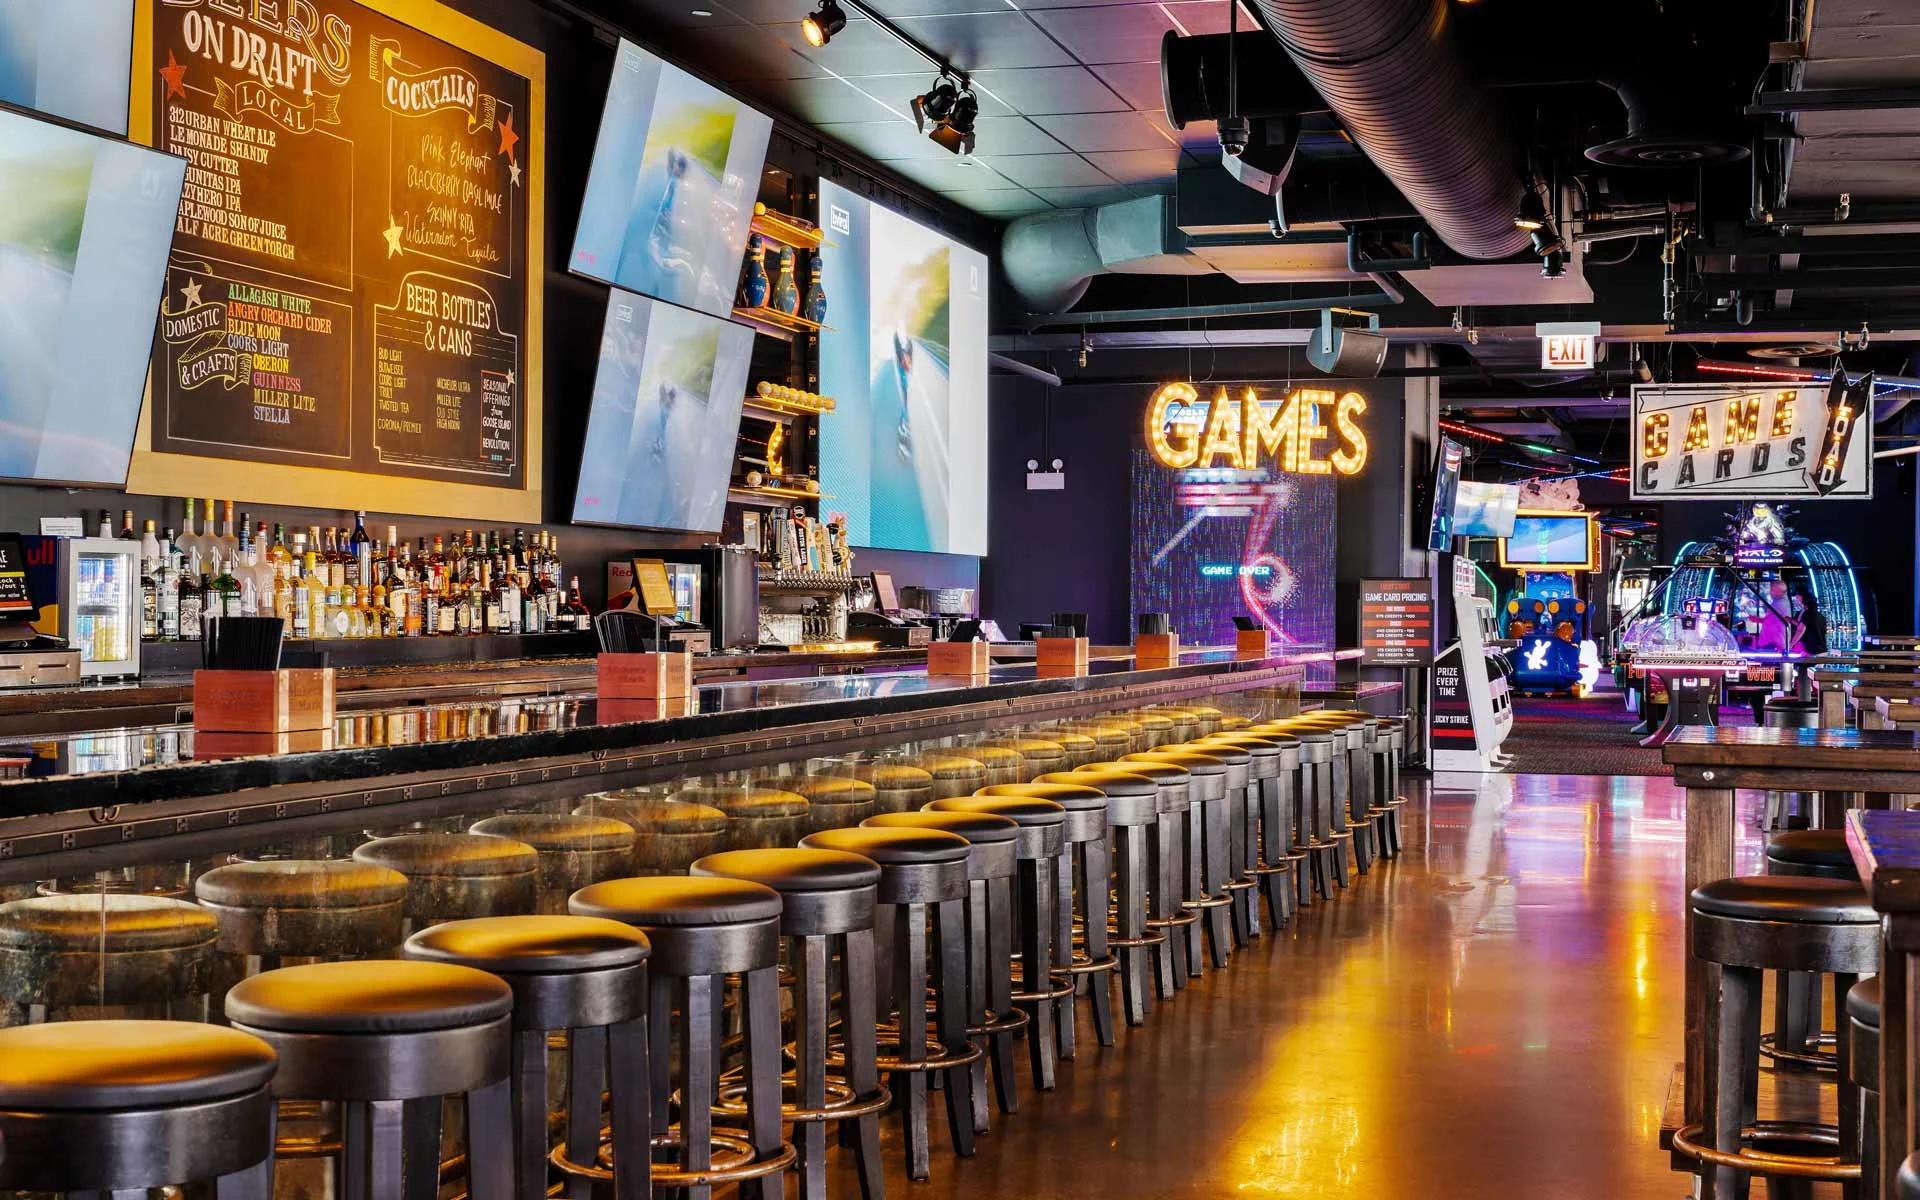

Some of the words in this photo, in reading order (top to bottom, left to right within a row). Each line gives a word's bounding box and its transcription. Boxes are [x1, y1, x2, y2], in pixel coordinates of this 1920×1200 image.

[163, 0, 352, 86] ERS
[183, 10, 225, 64] ON
[230, 25, 317, 96] DRAFT
[387, 74, 475, 110] COCKTAILS
[242, 86, 306, 130] LOCAL
[169, 106, 184, 124] 312
[185, 110, 220, 134] URBAN
[223, 120, 256, 142] WHEAT
[257, 128, 276, 147] ALE
[200, 152, 239, 176] CUTTER
[230, 139, 269, 165] SHANDY
[422, 134, 446, 162] Pink
[450, 141, 491, 174] Elephant
[185, 166, 224, 190] GUNITAS
[225, 177, 241, 195] IPA
[408, 164, 460, 198] BLACKBERRY
[225, 194, 241, 212] IPA
[179, 199, 228, 225] APLEWOOD
[260, 220, 287, 240] JUICE
[177, 215, 200, 236] ALF
[202, 222, 229, 244] ACRE
[230, 230, 264, 252] GREEN
[264, 238, 295, 260] TORCH
[228, 283, 279, 308] ALLAGASH
[281, 294, 312, 314] WHITE
[406, 283, 438, 318] BEER
[441, 292, 491, 330] BOTTLES
[166, 308, 220, 337] DOMESTIC
[228, 301, 259, 322] ANGRY
[261, 308, 303, 329] ORCHARD
[306, 317, 332, 334] CIDER
[228, 318, 254, 336] BLUE
[257, 324, 281, 341] MOON
[228, 333, 258, 352] COORS
[261, 341, 289, 358] LIGHT
[424, 320, 436, 351] &
[438, 325, 472, 357] CANS
[1549, 337, 1586, 360] EXIT
[253, 353, 289, 374] OBERON
[378, 347, 389, 360] BUD
[390, 348, 402, 361] LIGHT
[181, 363, 190, 386] &
[192, 353, 235, 379] CRAFTS
[379, 373, 392, 386] COORS
[393, 377, 407, 389] LIGHT
[253, 372, 301, 392] GUINNESS
[483, 378, 508, 394] SEASONAL
[253, 388, 289, 409] MILLER
[293, 395, 316, 412] LITE
[400, 402, 409, 414] TEA
[437, 393, 451, 407] MILLER
[452, 396, 462, 408] LITE
[483, 391, 511, 407] OFFERINGS
[253, 405, 290, 424] STELLA
[447, 408, 460, 420] STYLE
[483, 416, 497, 428] GOOSE
[498, 419, 511, 430] ISLAND
[1644, 390, 1798, 459] GAME
[1145, 382, 1368, 475] GAMES
[1819, 391, 1852, 485] LOAD
[483, 437, 510, 451] REVOLUTION
[1641, 436, 1807, 491] CARDS
[27, 538, 55, 565] ull
[1738, 549, 1784, 557] HALO
[612, 566, 633, 577] Red
[1202, 566, 1233, 575] GAME
[1239, 566, 1270, 575] OVER
[1365, 593, 1382, 602] GAME
[1384, 593, 1401, 602] CARD
[1401, 593, 1427, 602] PRICING
[1436, 677, 1459, 686] EVERY
[1437, 667, 1458, 676] PRIZE
[1747, 667, 1775, 681] WIN
[1439, 687, 1456, 696] TIME
[1450, 715, 1469, 724] STRIKE
